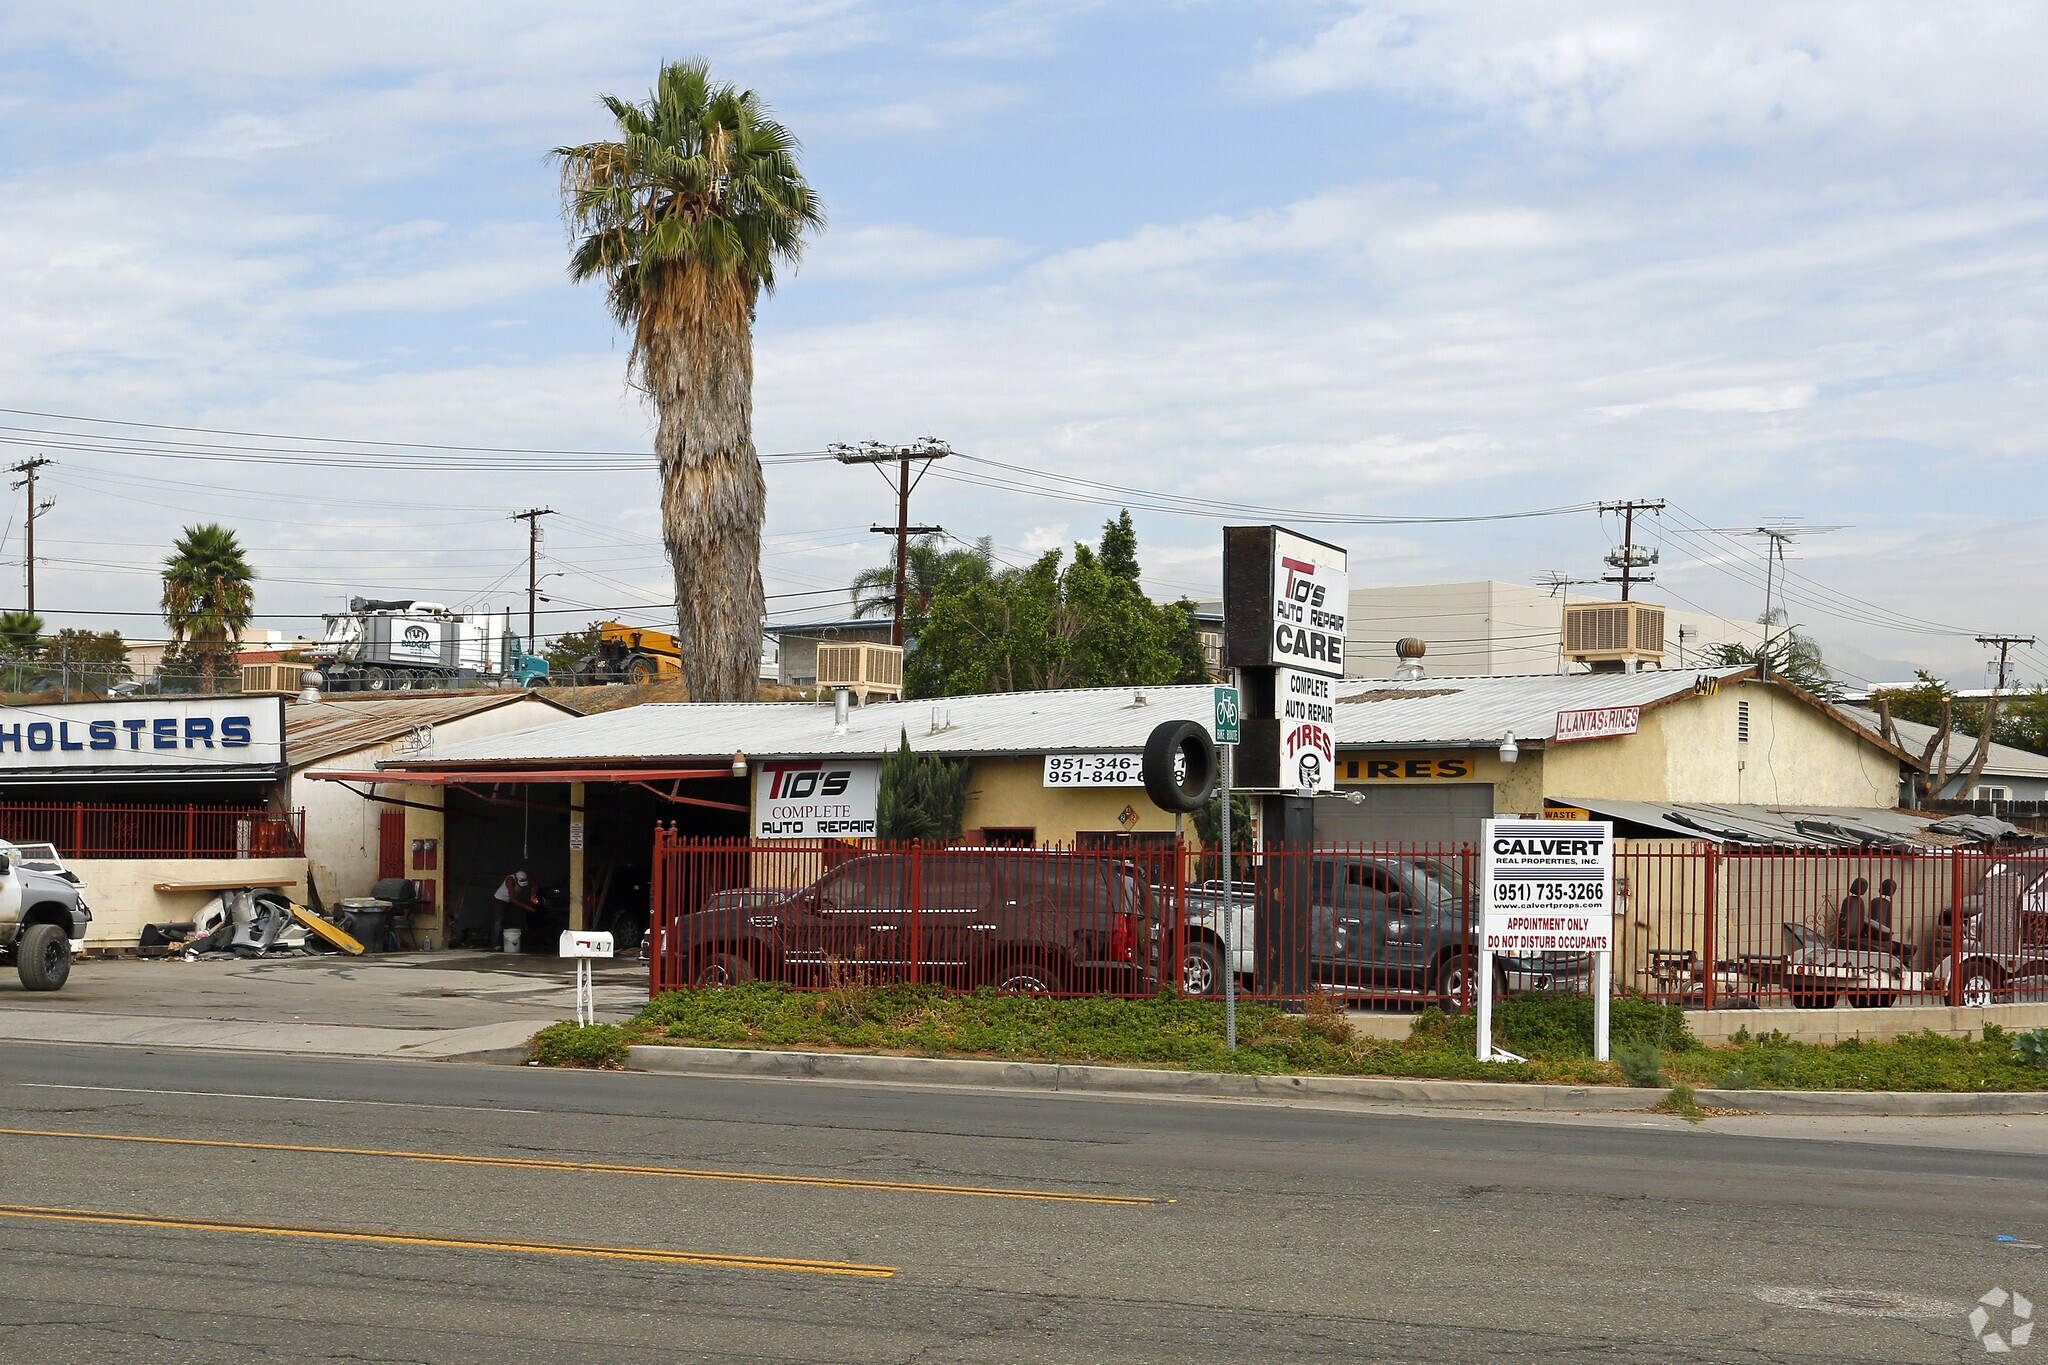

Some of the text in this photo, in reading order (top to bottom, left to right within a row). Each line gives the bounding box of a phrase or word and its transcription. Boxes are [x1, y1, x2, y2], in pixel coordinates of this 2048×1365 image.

[1277, 600, 1345, 632] AUTO REPAIR
[1276, 624, 1342, 664] CARE
[1290, 674, 1329, 699] COMPLETE
[1695, 674, 1718, 696] 6417
[1285, 700, 1334, 723] AUTO REPAIR
[1559, 711, 1605, 733] LLANTAS
[1608, 708, 1638, 729] RINES
[0, 716, 251, 752] HOLSTERS
[1287, 724, 1332, 763] TIRES
[1050, 757, 1186, 770] 951-346-1
[762, 761, 852, 800] TIO'S
[1049, 771, 1185, 783] 951-840-68
[772, 805, 851, 820] COMPLETE
[1545, 811, 1576, 819] WASTE
[762, 820, 875, 834] AUTO REPAIR
[1493, 839, 1604, 856] CALVERT
[1521, 858, 1578, 866] PROPERTIES,
[1493, 883, 1604, 901] (951) 735-3266
[1494, 902, 1602, 910] www.calvertprops.com
[1507, 917, 1589, 931] APPOINTMENT ONLY
[1488, 935, 1607, 949] DO NOT DISTURB OCCUPANTS
